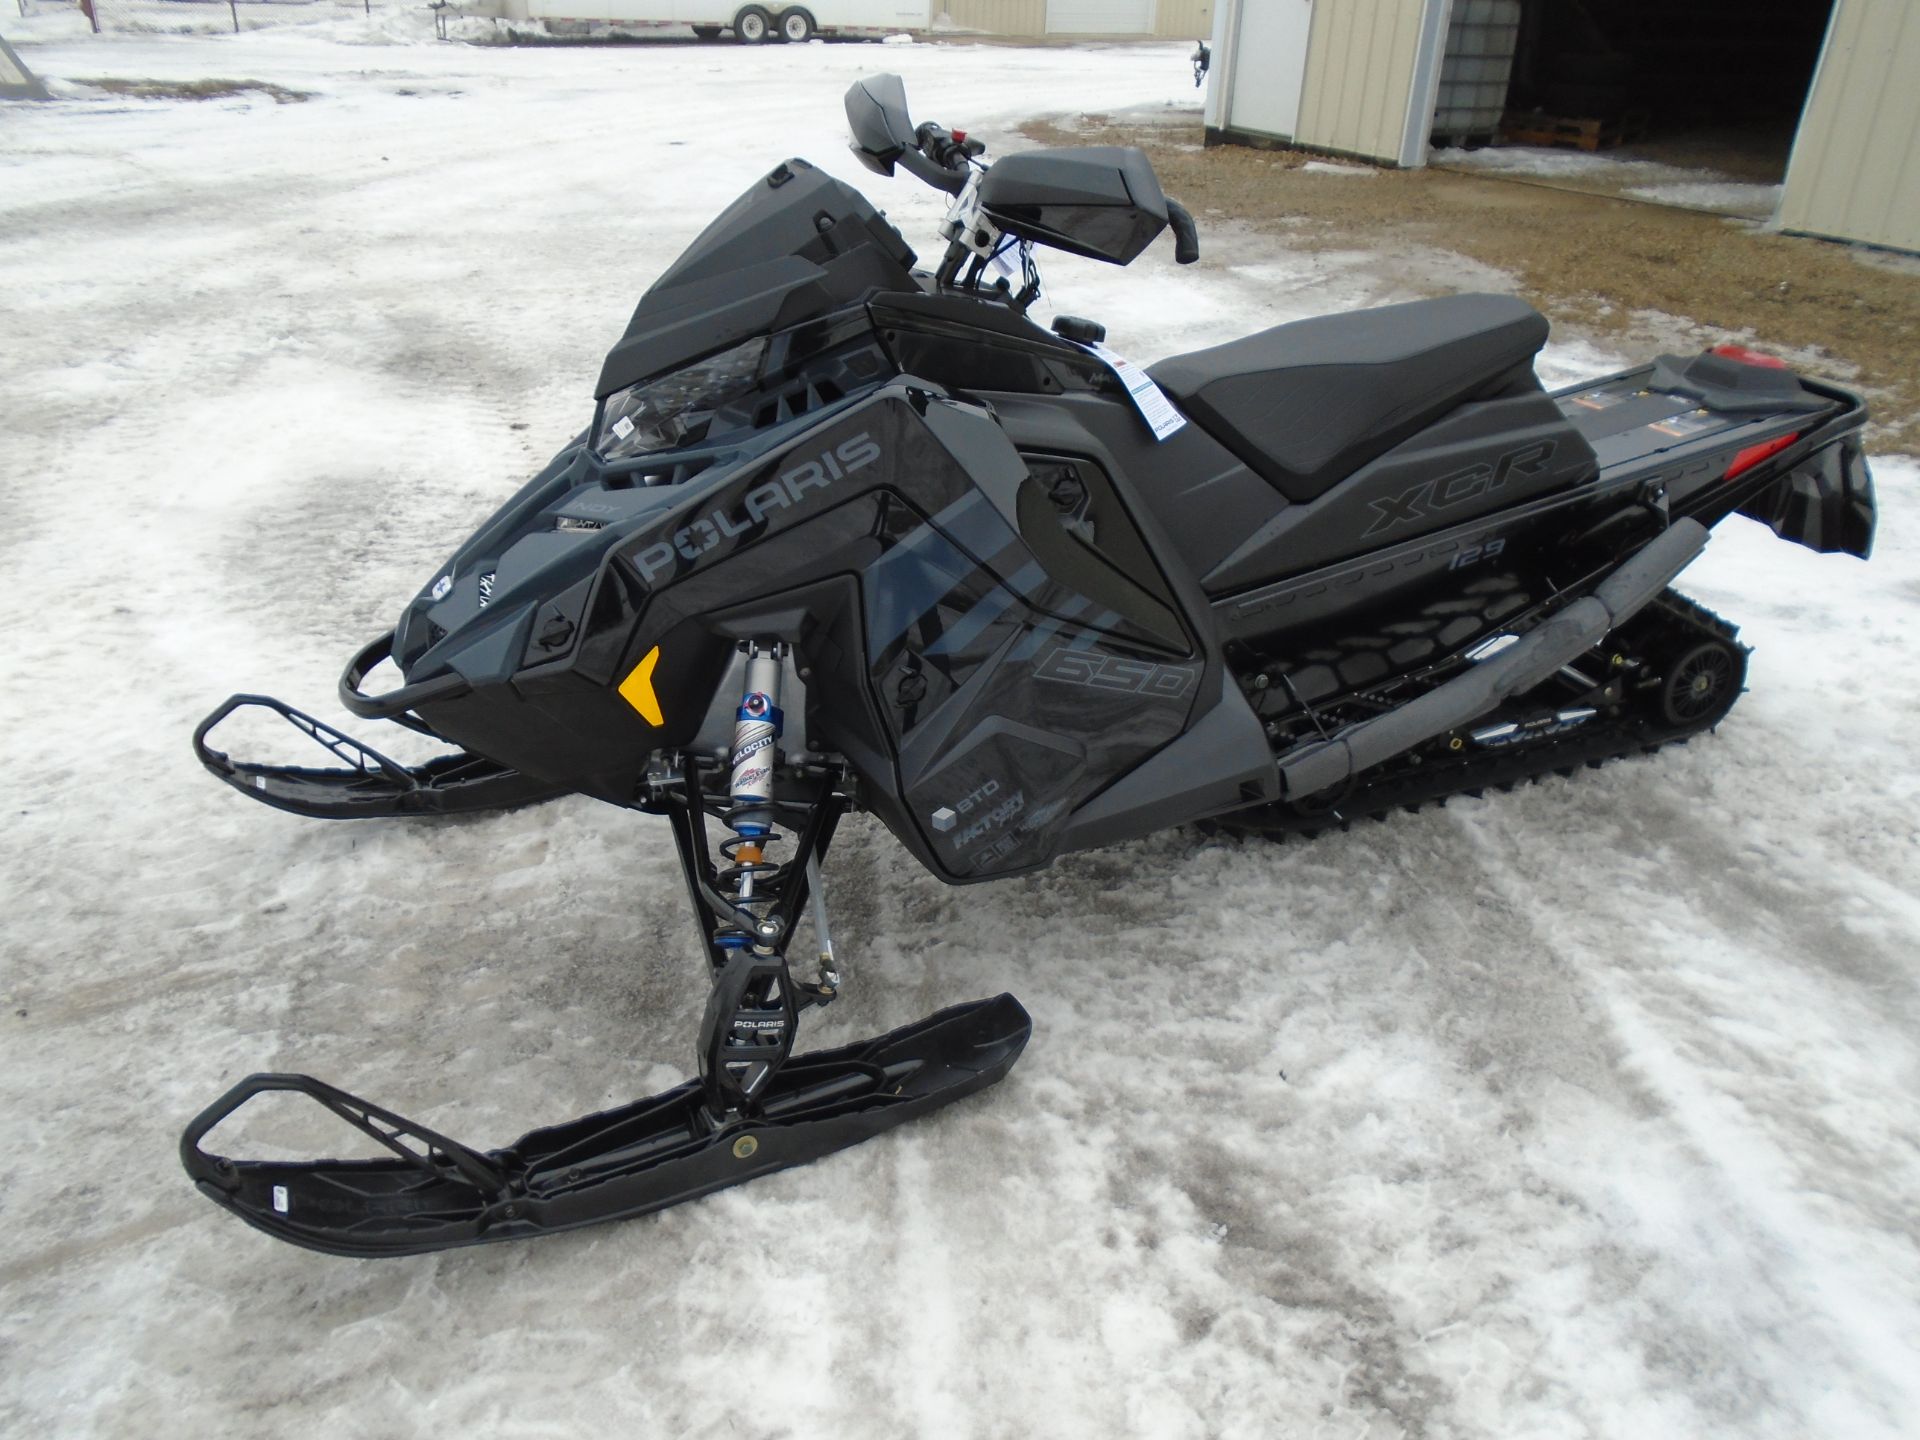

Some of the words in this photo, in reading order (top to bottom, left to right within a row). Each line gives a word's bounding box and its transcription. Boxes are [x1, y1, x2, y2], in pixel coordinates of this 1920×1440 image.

[632, 431, 882, 583] POLARIS
[1359, 439, 1559, 541] XCR
[1447, 537, 1506, 571] 129
[1032, 647, 1196, 698] 650
[732, 735, 772, 765] VELOCITY
[734, 1020, 785, 1028] POLARIS
